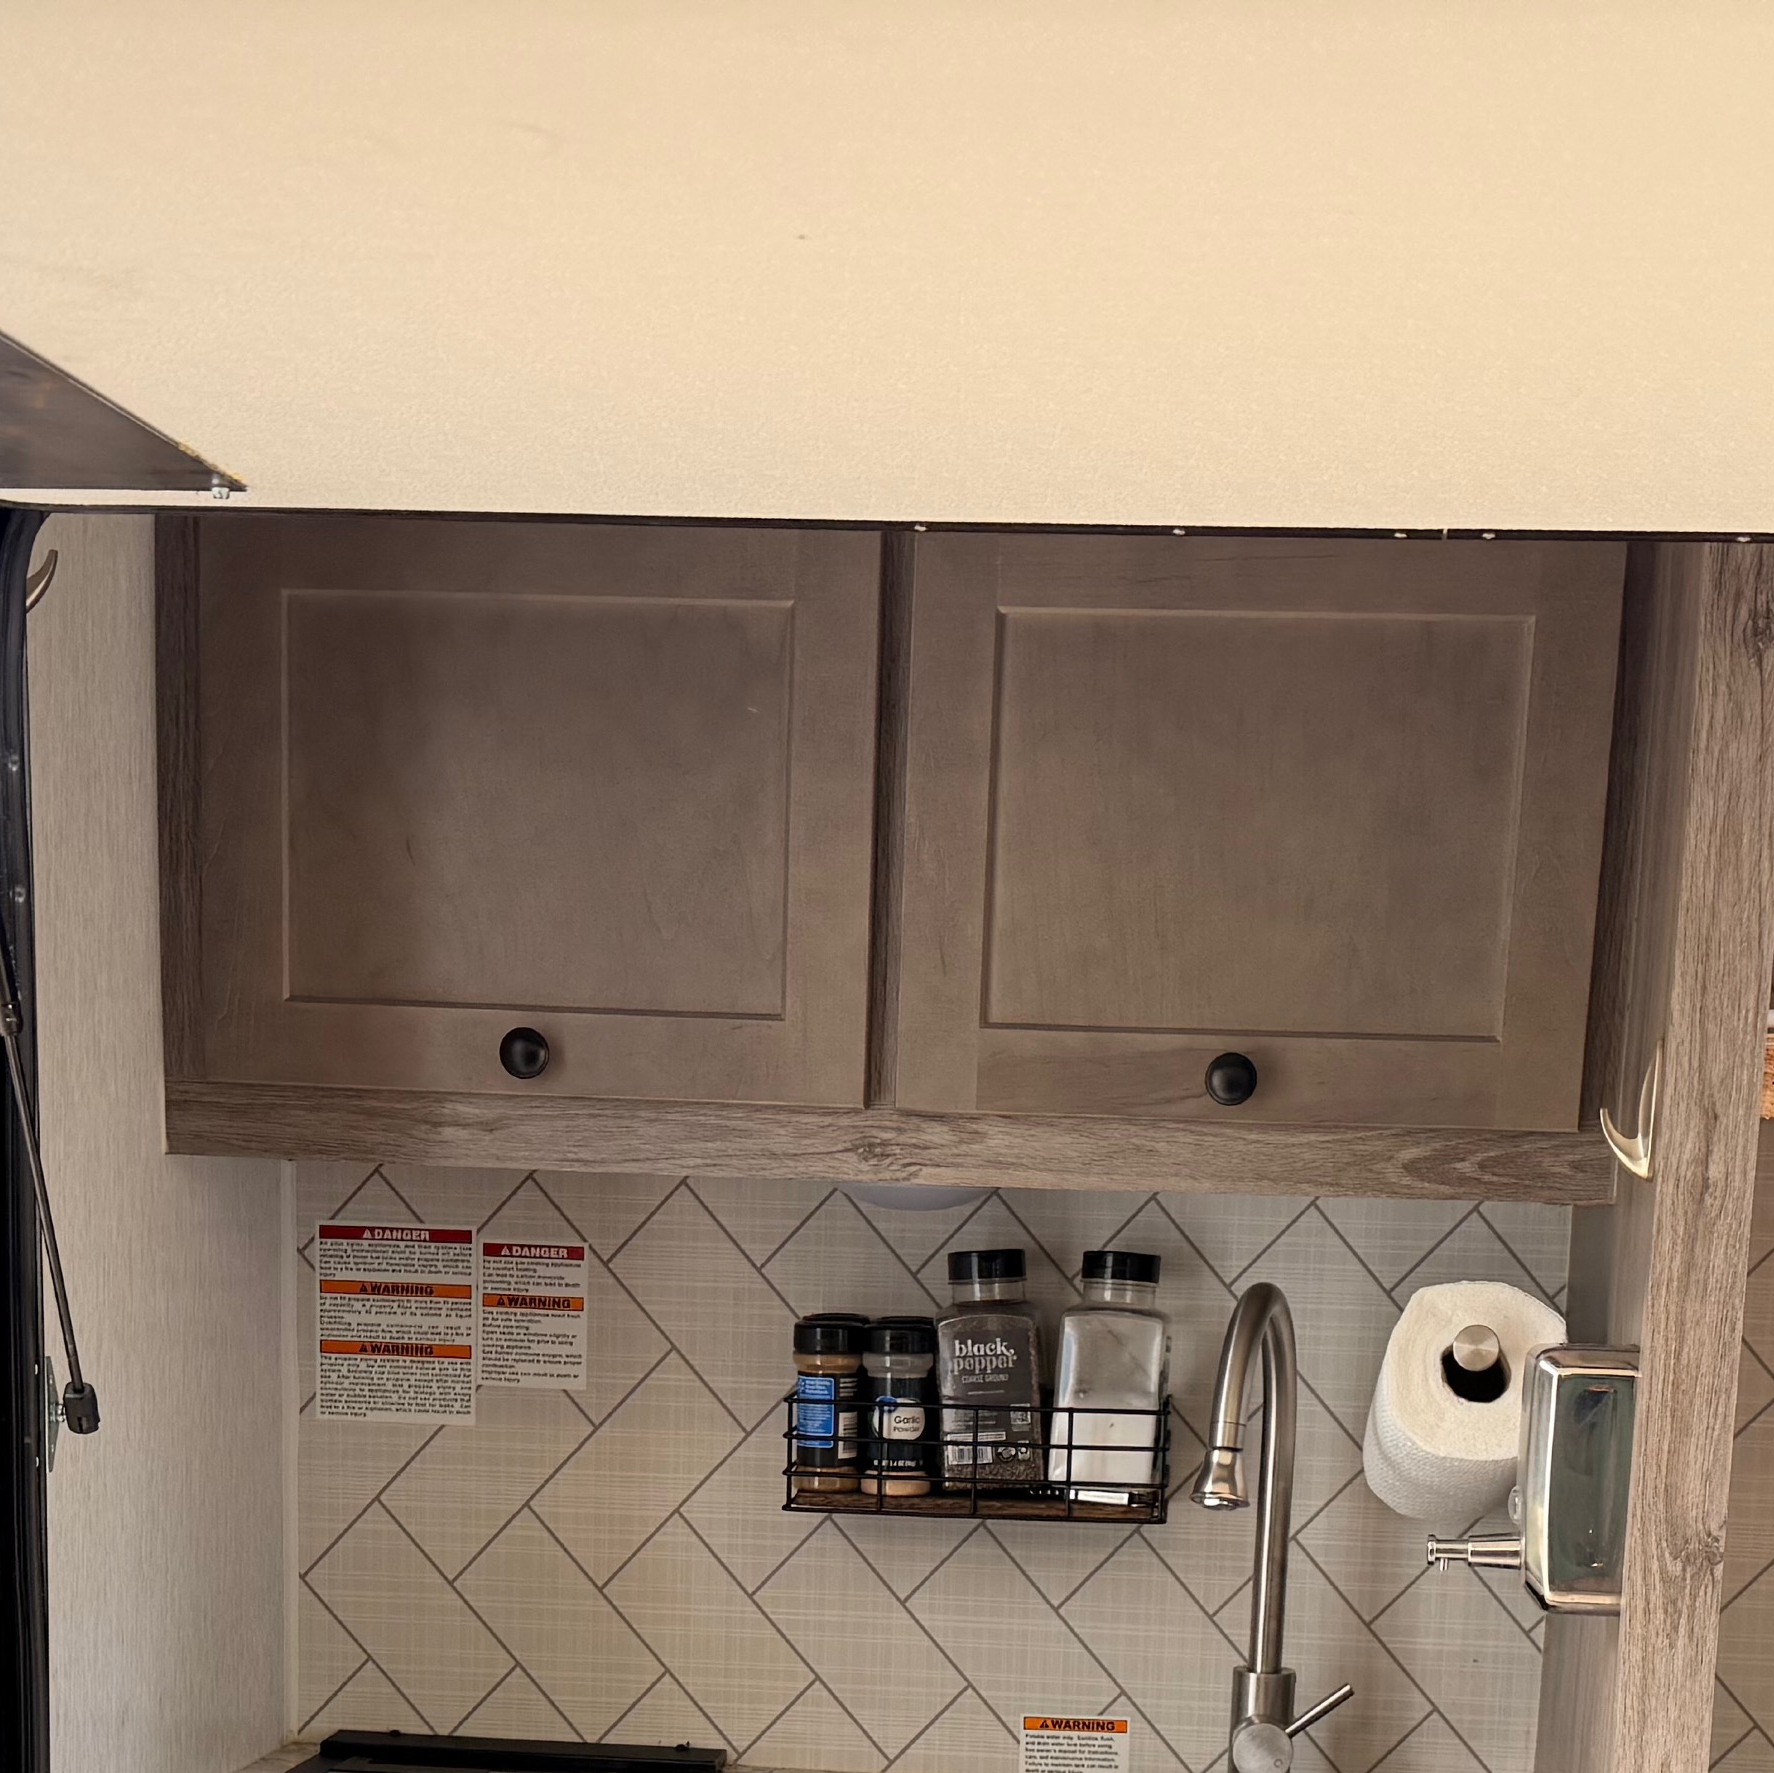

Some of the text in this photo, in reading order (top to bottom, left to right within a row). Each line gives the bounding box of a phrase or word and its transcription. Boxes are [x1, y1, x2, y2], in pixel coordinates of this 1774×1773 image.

[374, 1229, 430, 1241] DANGER
[512, 1246, 568, 1258] DANGER
[370, 1283, 434, 1295] WARNING
[507, 1297, 571, 1308] WARNING
[370, 1343, 434, 1355] WARNING
[954, 1337, 1015, 1356] black
[953, 1355, 1017, 1375] pepper
[894, 1415, 921, 1424] Garlic
[1051, 1720, 1115, 1731] WARNING
